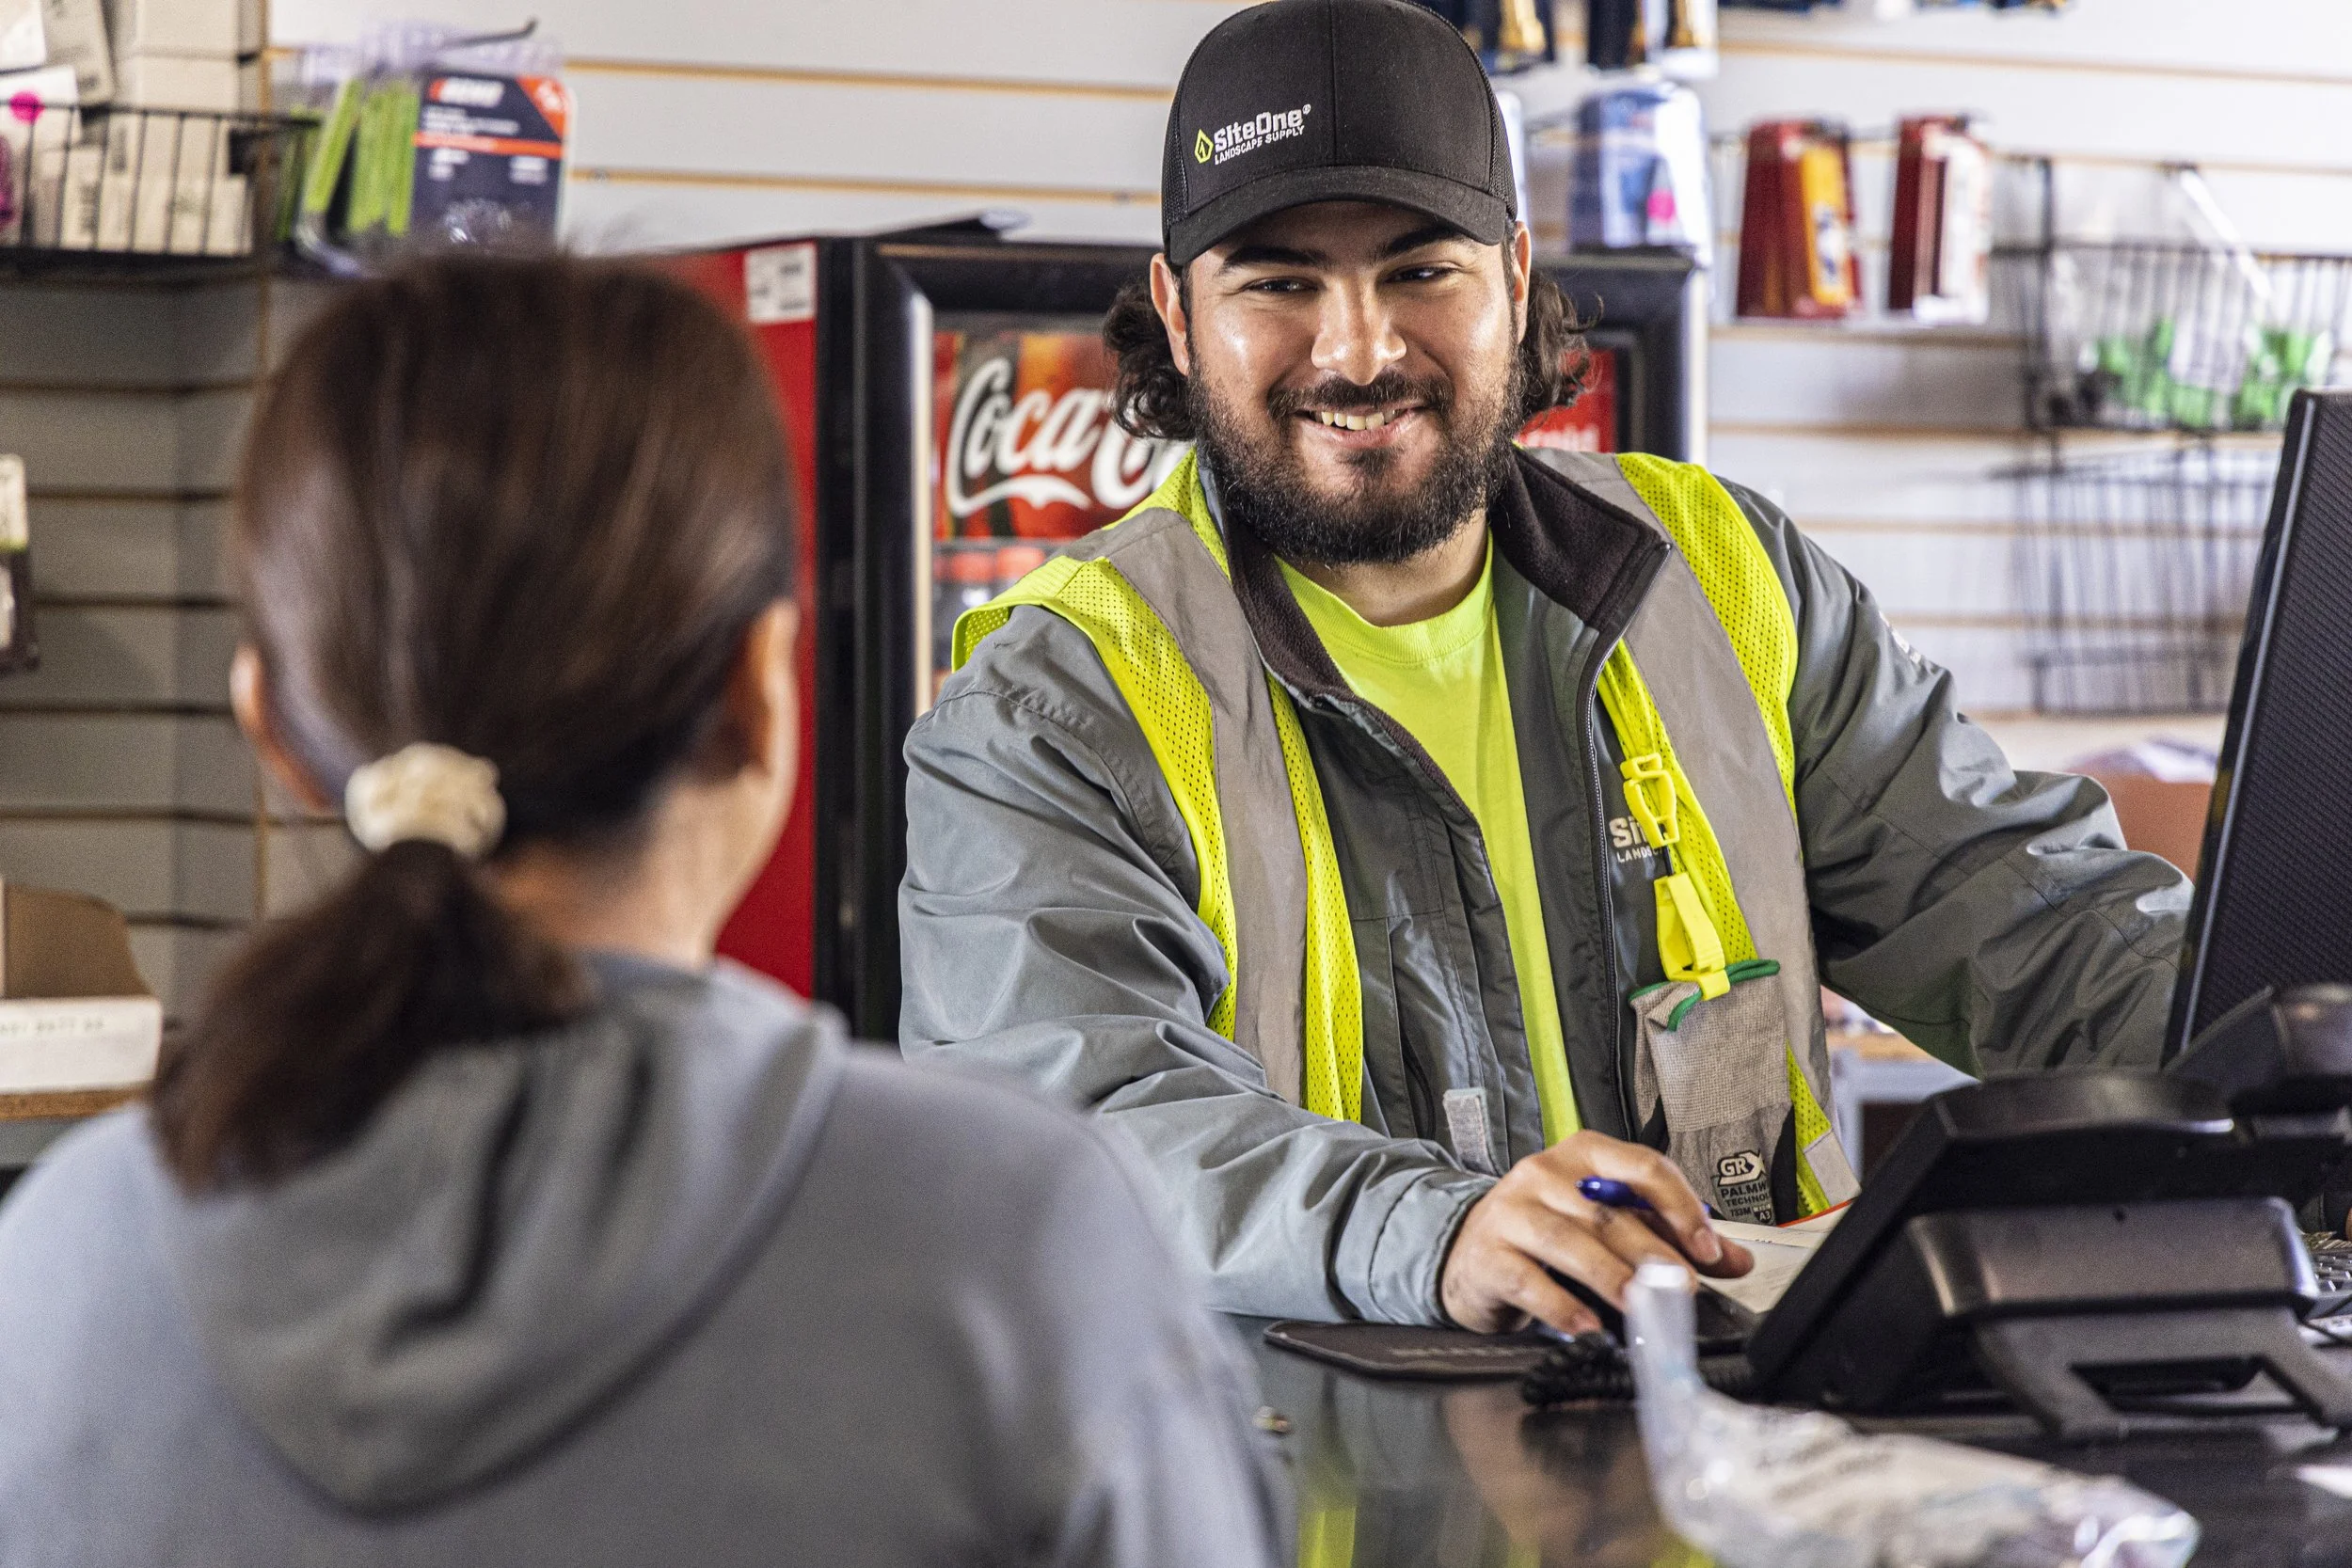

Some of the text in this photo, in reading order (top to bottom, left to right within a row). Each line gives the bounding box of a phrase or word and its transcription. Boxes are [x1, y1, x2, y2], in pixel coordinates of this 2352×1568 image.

[1215, 125, 1305, 166] LANDSCAPE SUPPLY
[1759, 1209, 1772, 1221] A3
